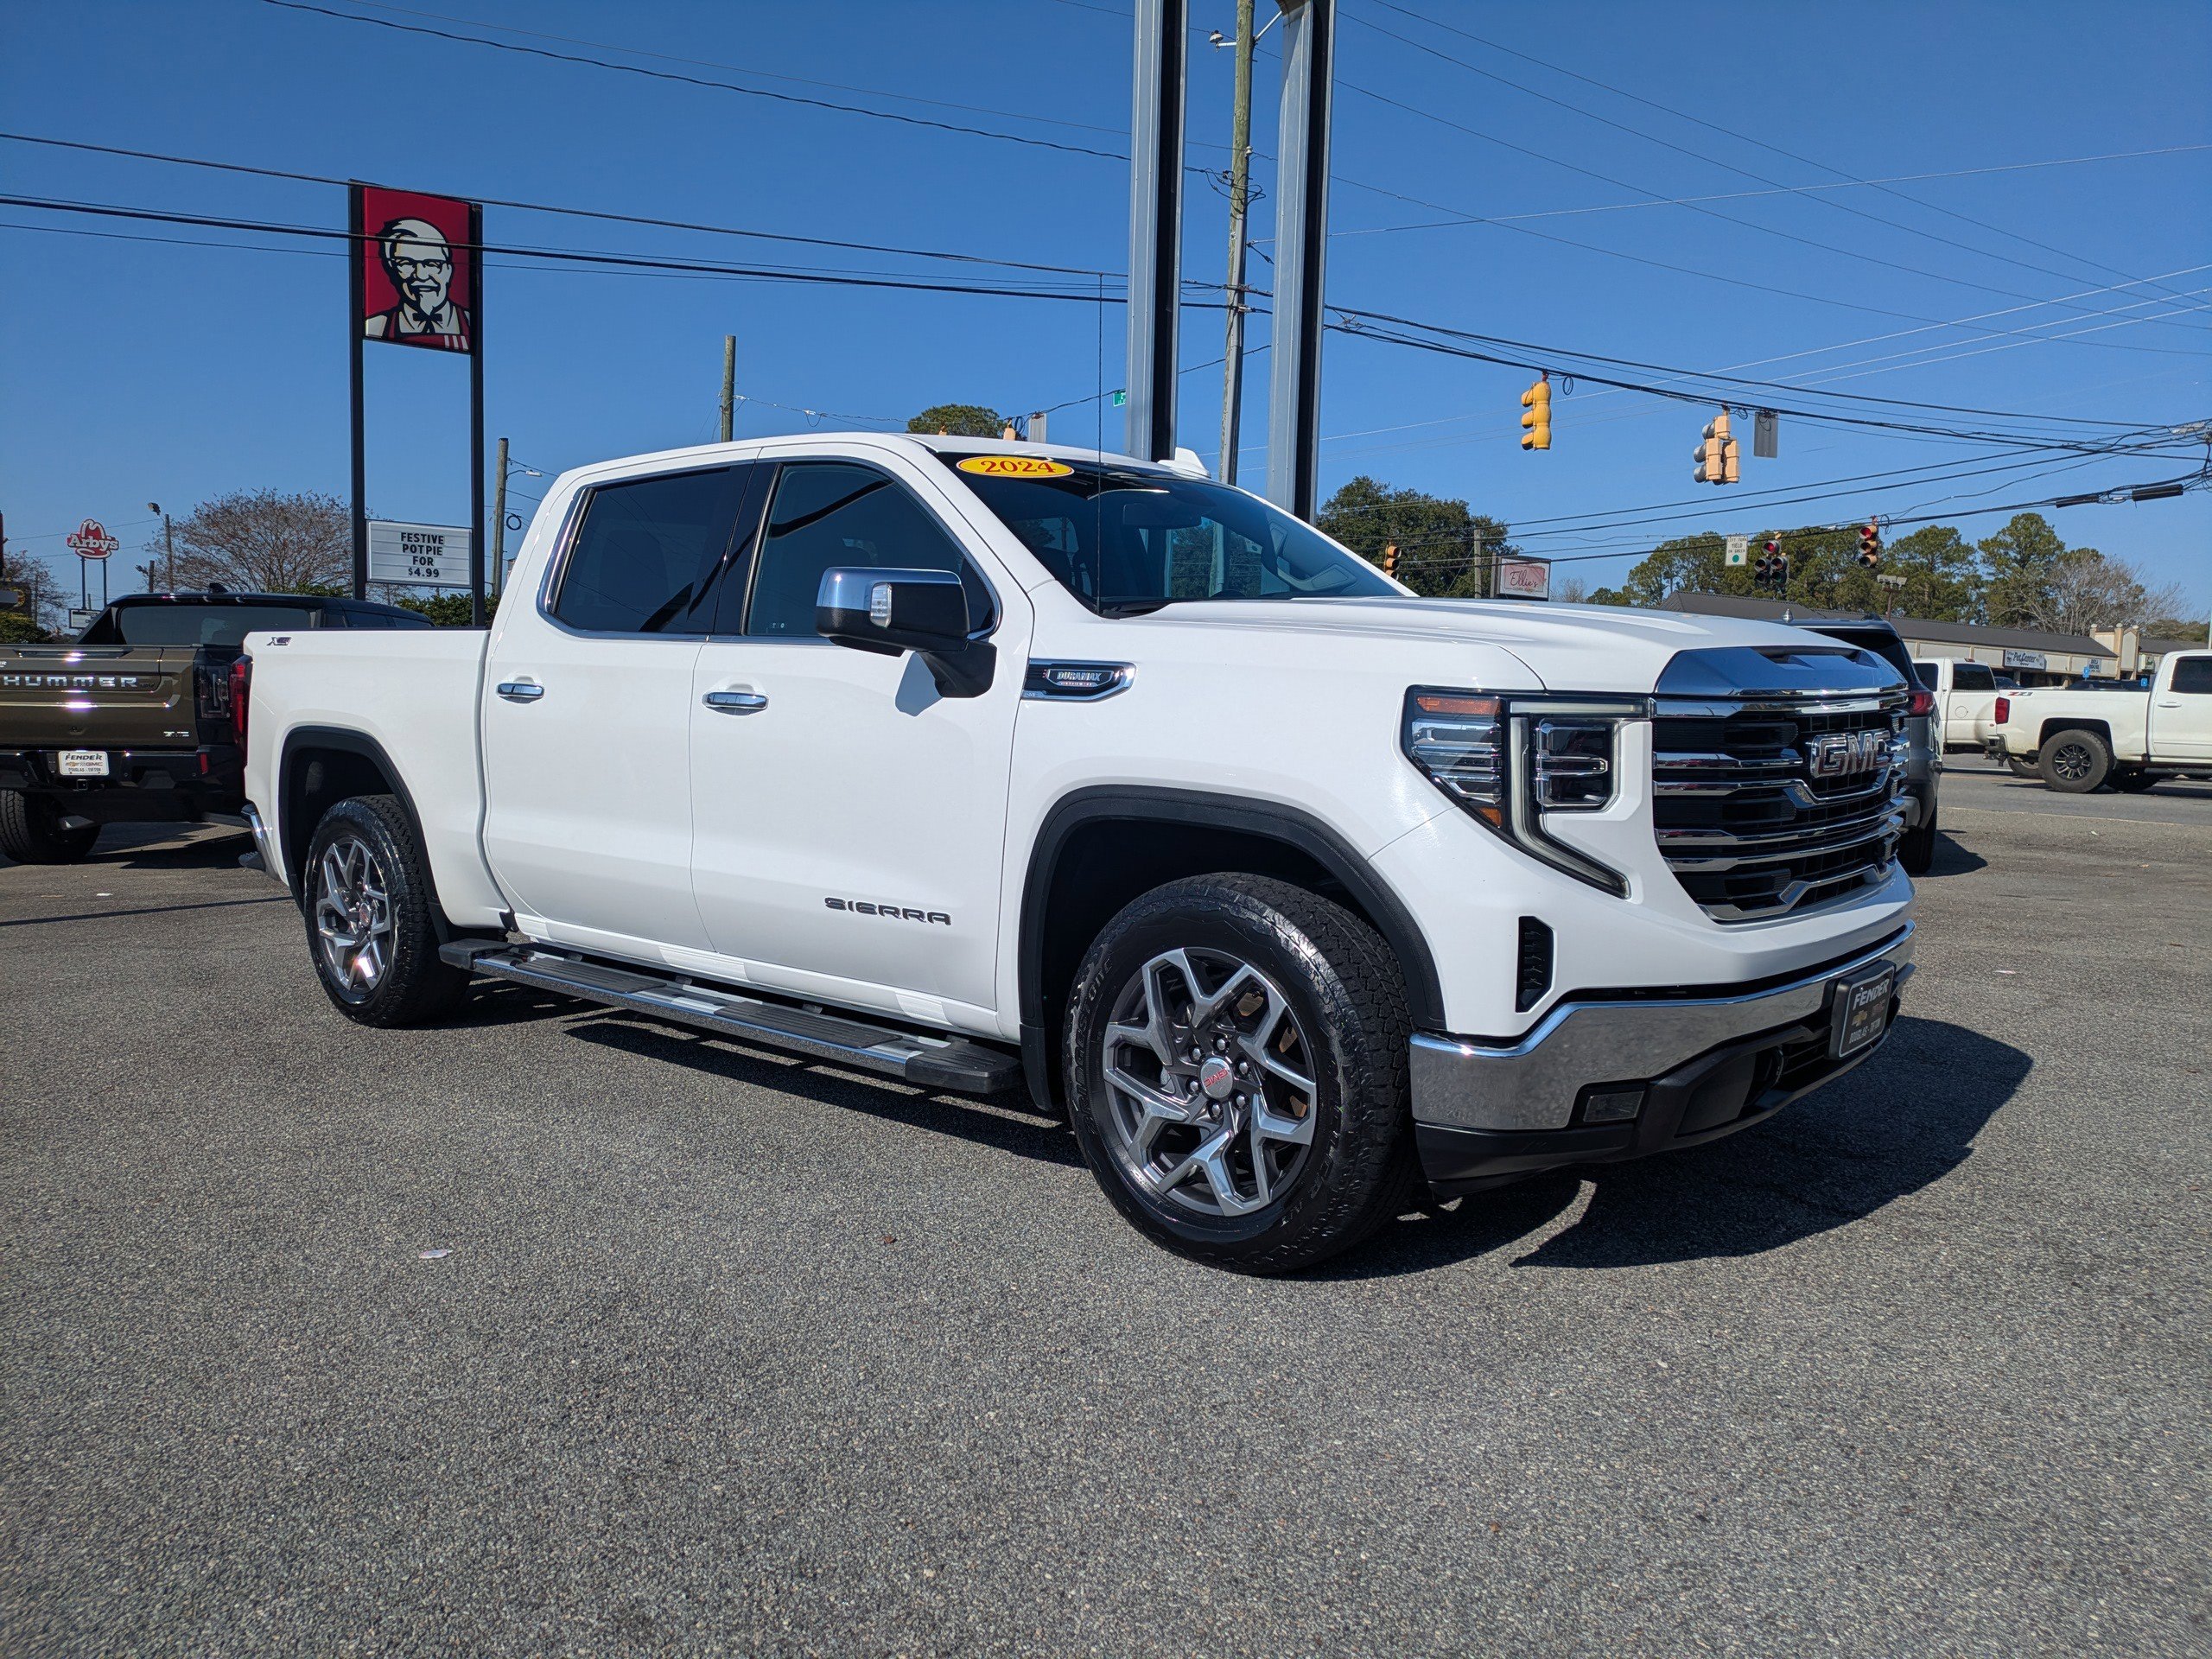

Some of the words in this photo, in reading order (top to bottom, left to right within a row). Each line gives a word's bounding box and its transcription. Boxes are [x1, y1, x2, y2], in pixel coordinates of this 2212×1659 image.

[980, 460, 1056, 473] 2024
[69, 534, 119, 551] Arby's
[400, 532, 444, 544] FESTIVE
[412, 556, 435, 567] FOR
[408, 567, 440, 578] $4.99
[1510, 569, 1538, 588] Ellie's
[3, 676, 138, 688] HUMMER
[1056, 671, 1103, 682] DURAMAX
[1810, 728, 1892, 778] GMC
[824, 897, 952, 926] SIERRA
[1853, 978, 1890, 1011] FENDER
[1204, 1067, 1229, 1090] GMC
